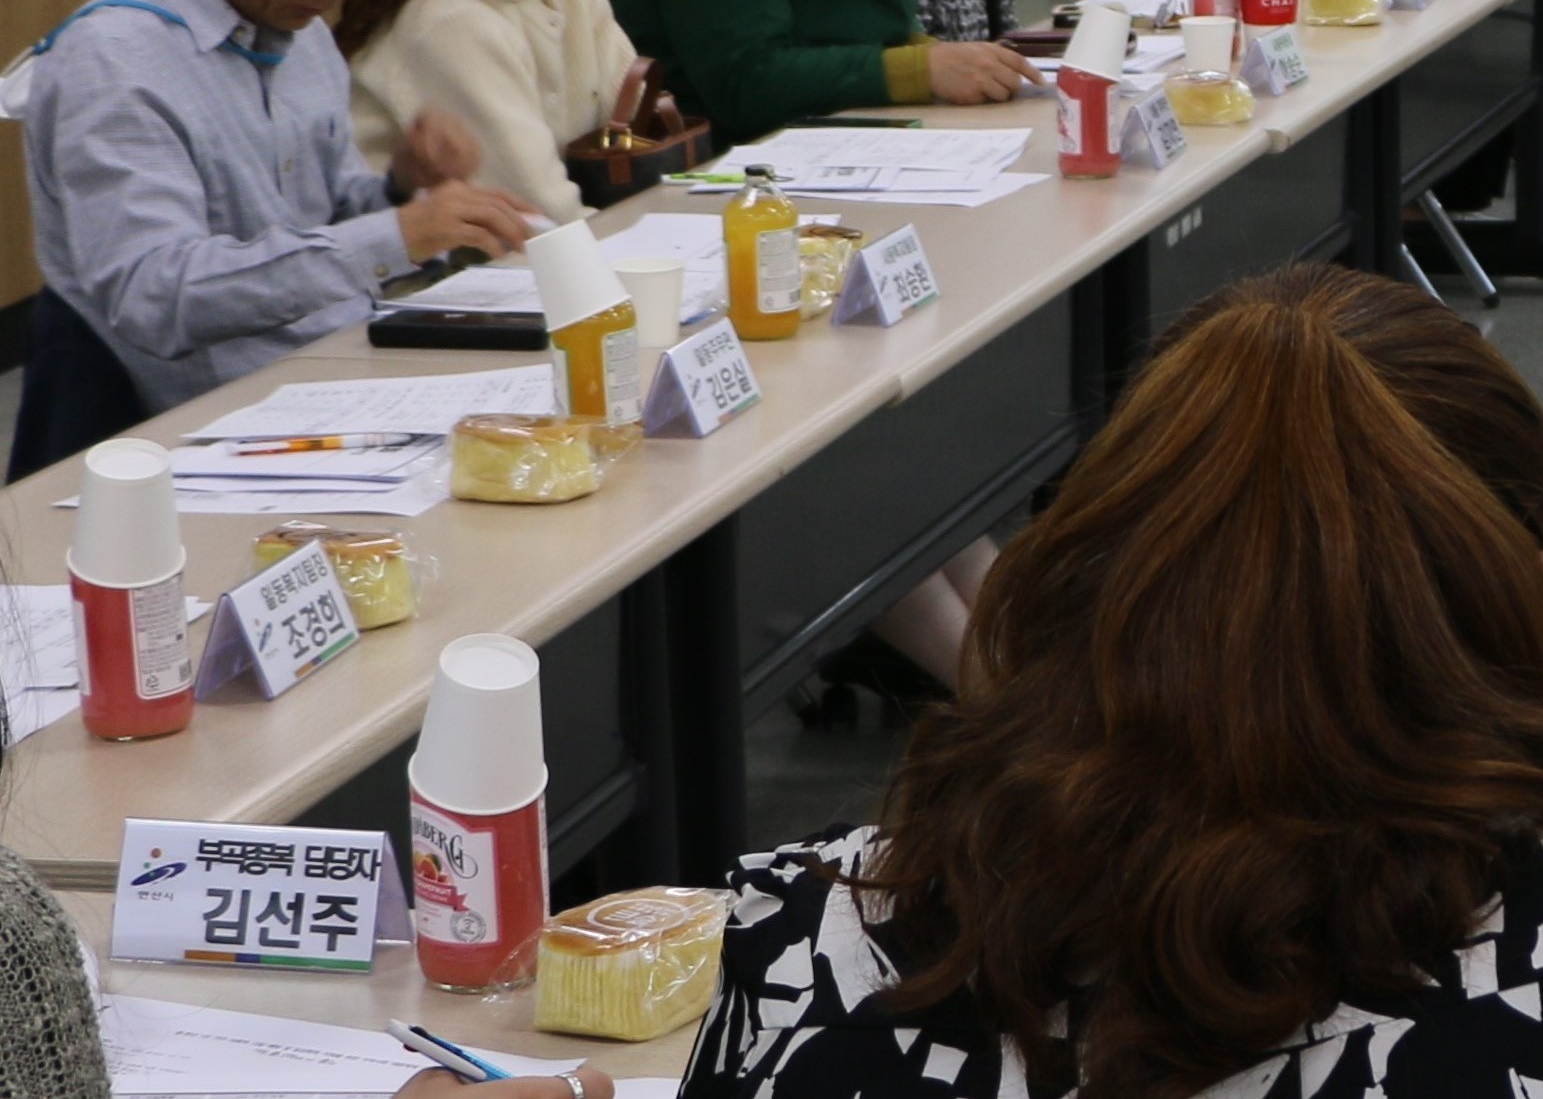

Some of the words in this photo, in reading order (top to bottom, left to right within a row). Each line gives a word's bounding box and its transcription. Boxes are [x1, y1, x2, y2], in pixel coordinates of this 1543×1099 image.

[281, 588, 347, 660] 조경희
[304, 844, 383, 882] 담당자
[202, 887, 359, 953] 김선주
